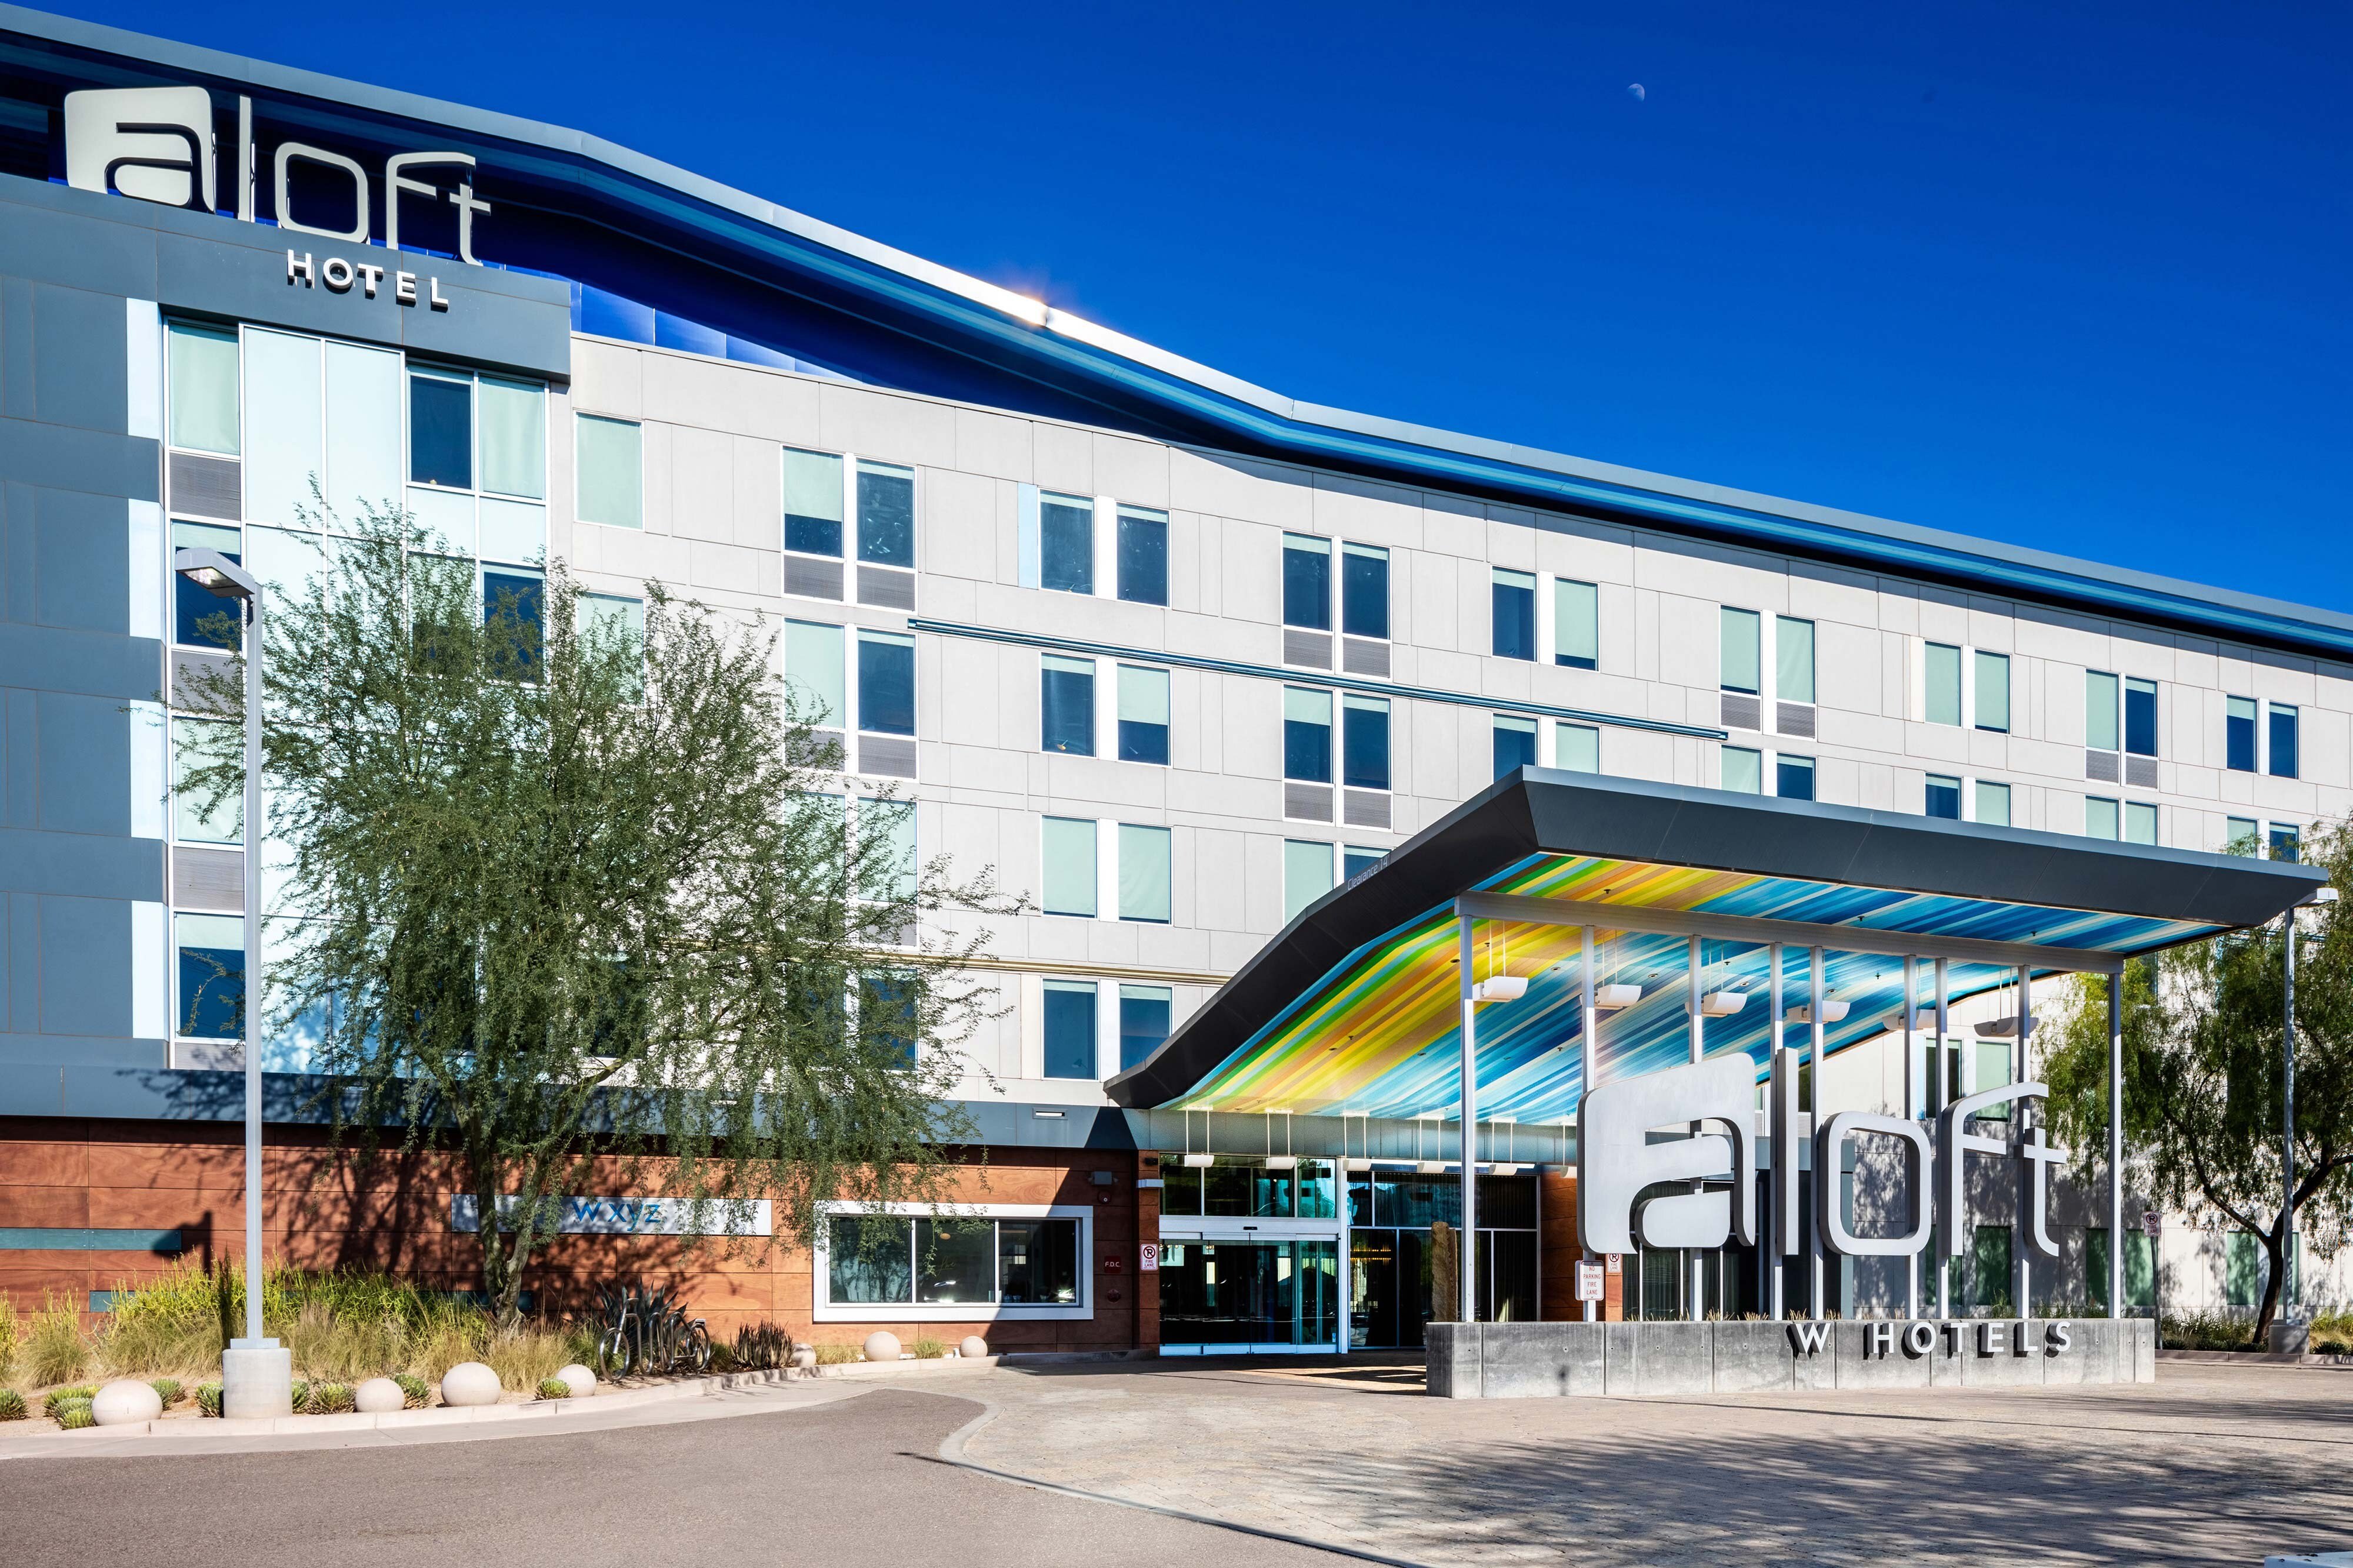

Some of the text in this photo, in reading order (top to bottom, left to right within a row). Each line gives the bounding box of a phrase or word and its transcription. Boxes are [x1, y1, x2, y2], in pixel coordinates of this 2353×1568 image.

[64, 85, 492, 266] aloft
[287, 249, 449, 309] HOTEL
[1348, 864, 1378, 891] Clearance
[1577, 1052, 2067, 1257] aloft
[1791, 1321, 2072, 1355] W HOTELS
